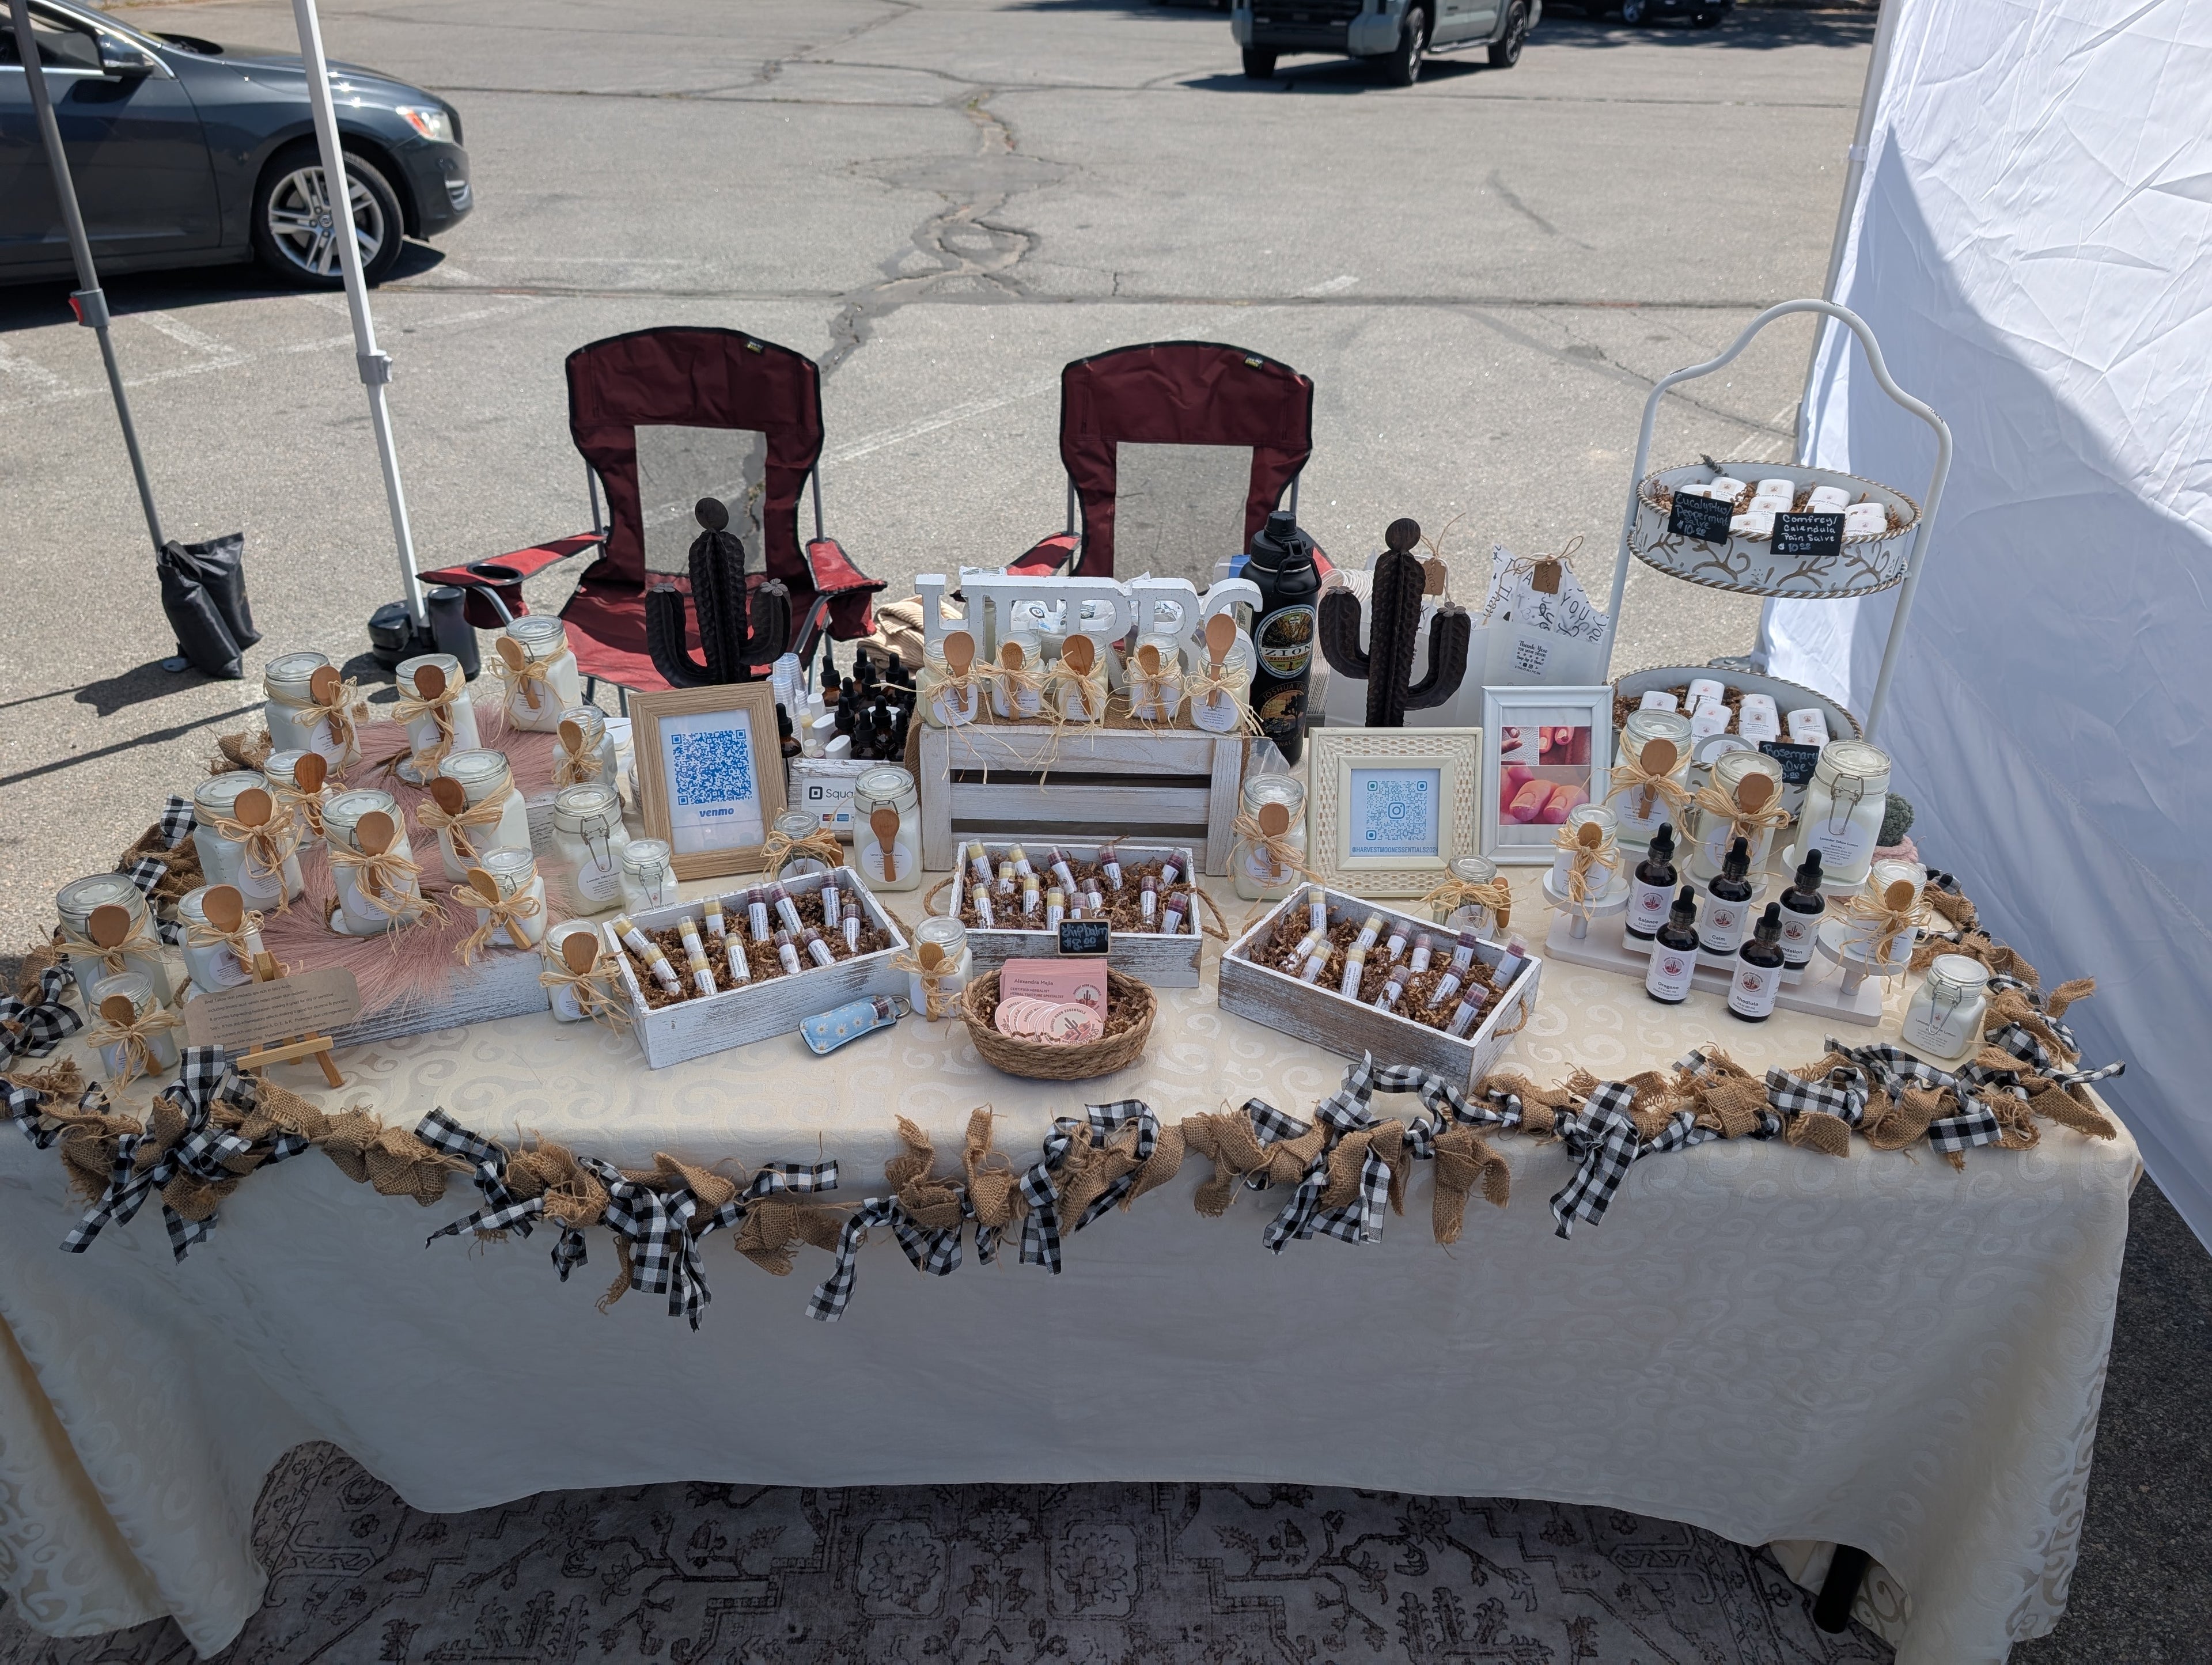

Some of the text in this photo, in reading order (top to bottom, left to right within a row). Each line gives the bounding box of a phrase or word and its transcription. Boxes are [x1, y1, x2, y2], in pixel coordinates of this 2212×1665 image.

[1675, 505, 1728, 526] Peppermint
[1783, 525, 1836, 533] Calendula
[1781, 533, 1804, 541] Pain
[1265, 643, 1312, 656] ZION
[1519, 640, 1548, 654] Thank You
[1262, 683, 1295, 701] JOSHUA
[1763, 744, 1819, 767] Rosemary
[825, 788, 854, 801] Squa
[699, 807, 734, 817] venmo
[1638, 916, 1658, 924] Balance
[1779, 945, 1802, 954] andelion
[1657, 981, 1679, 990] Oregano
[1736, 996, 1759, 1007] Rhodiola
